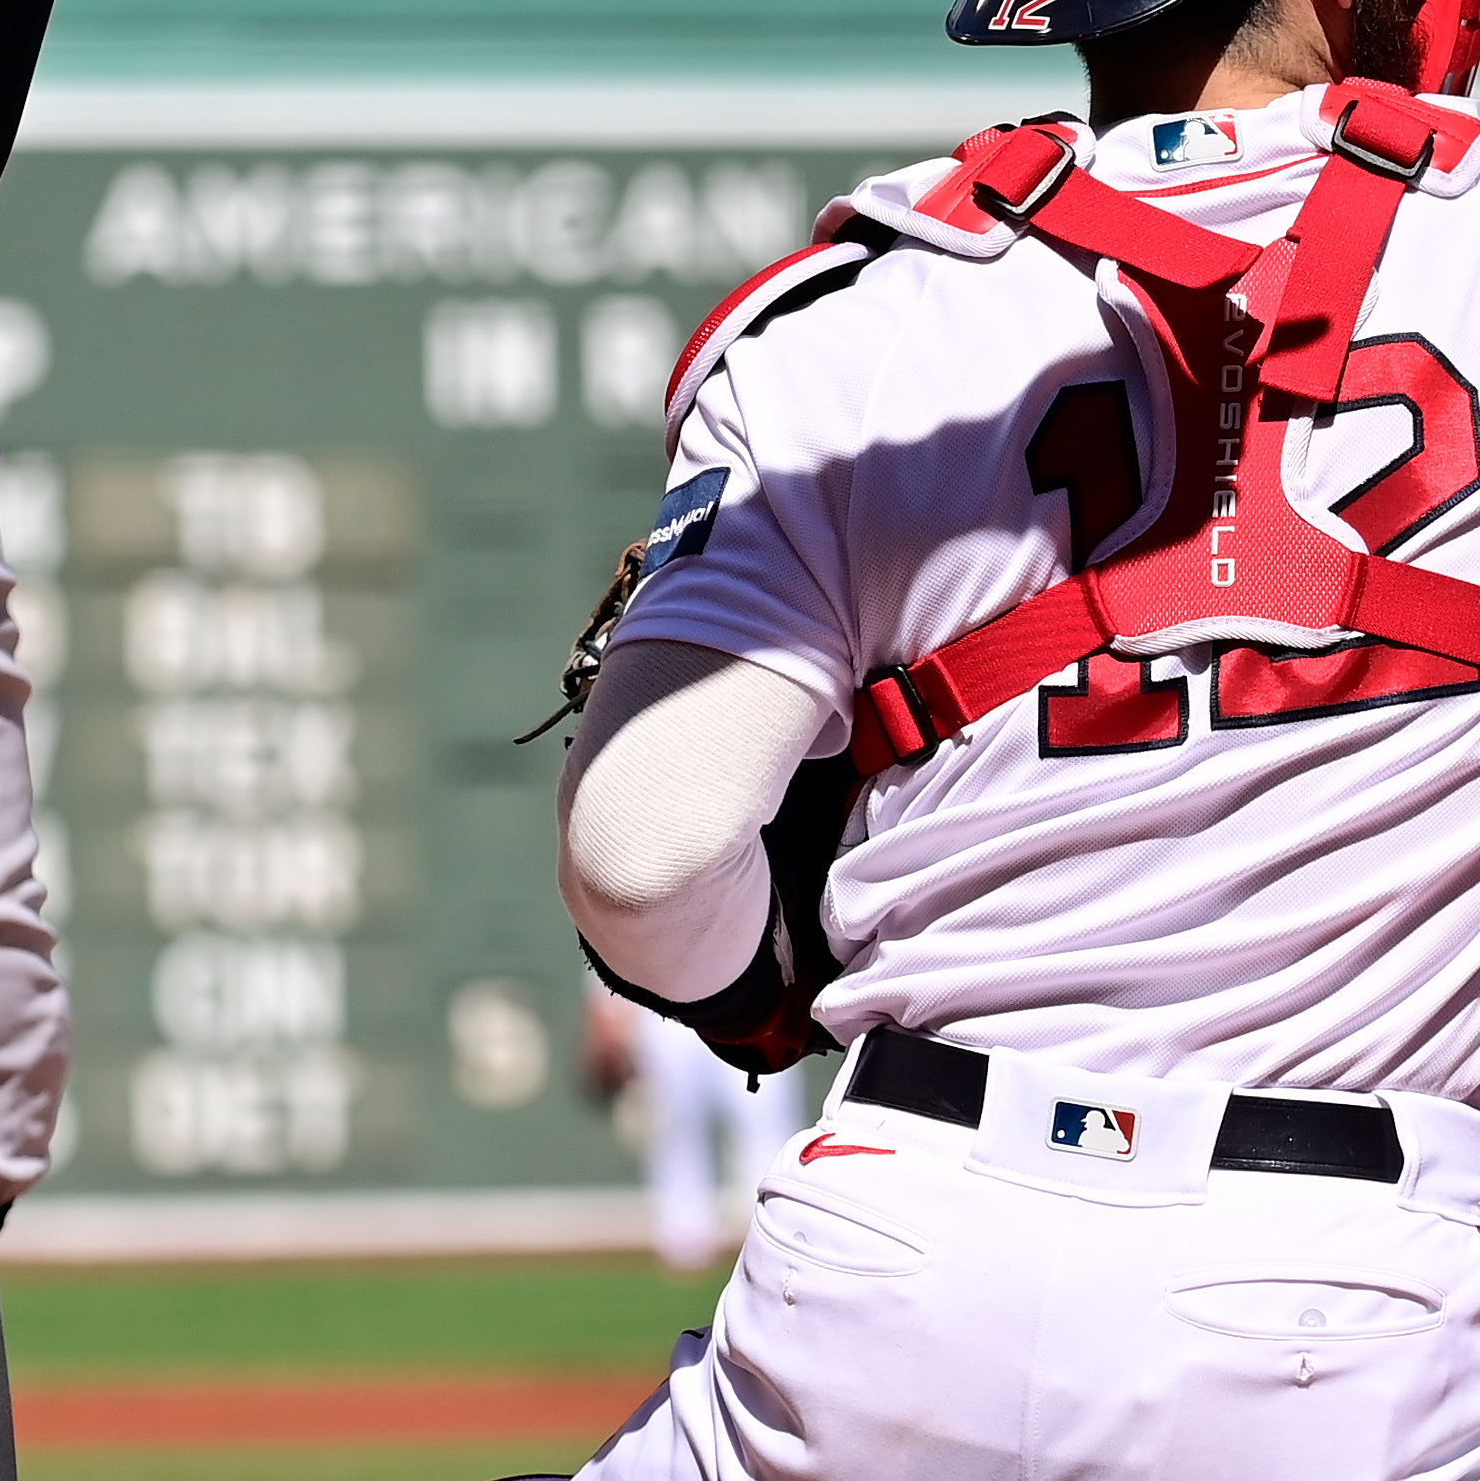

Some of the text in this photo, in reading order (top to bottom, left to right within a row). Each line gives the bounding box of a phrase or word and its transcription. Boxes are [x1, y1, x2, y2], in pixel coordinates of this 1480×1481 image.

[87, 161, 807, 287] AMERICAN
[1210, 292, 1249, 589] EVOSHIELD
[125, 571, 352, 693] BAL
[141, 699, 355, 809] TEX
[141, 811, 361, 929] TOR
[153, 931, 345, 1047] CIN
[131, 1051, 353, 1173] DET
